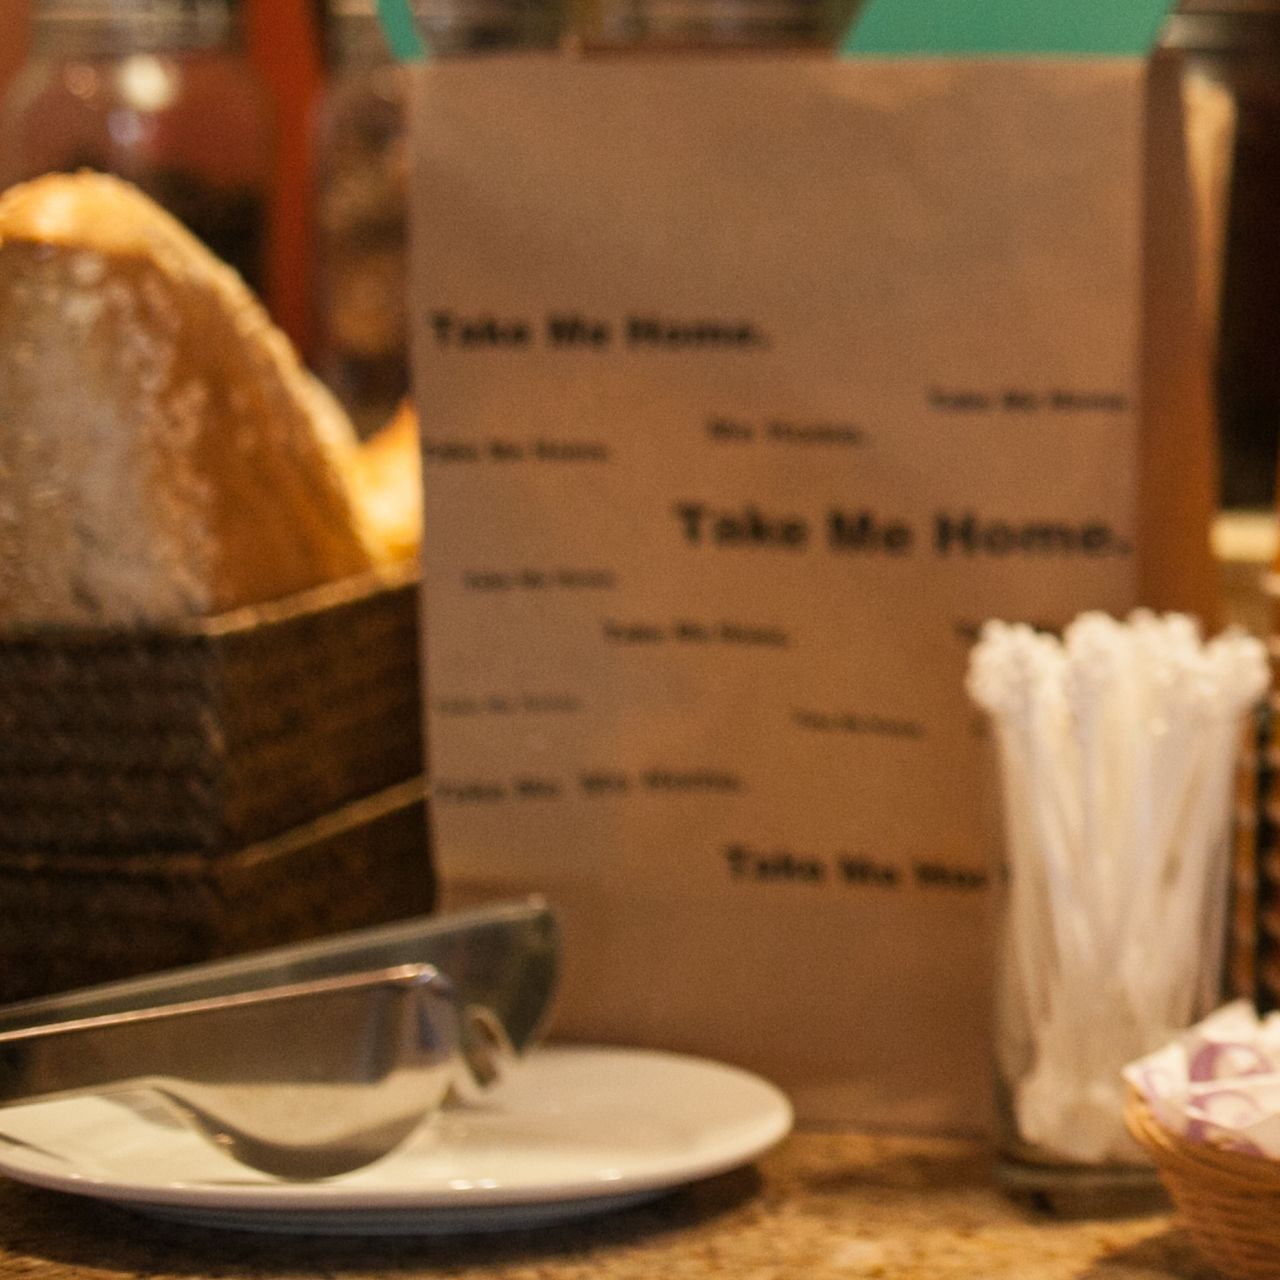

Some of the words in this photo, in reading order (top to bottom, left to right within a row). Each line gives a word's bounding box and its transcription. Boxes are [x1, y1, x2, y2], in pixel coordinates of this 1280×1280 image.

[676, 502, 807, 550] Take
[828, 506, 915, 555] Me
[932, 509, 1133, 557] Home.
